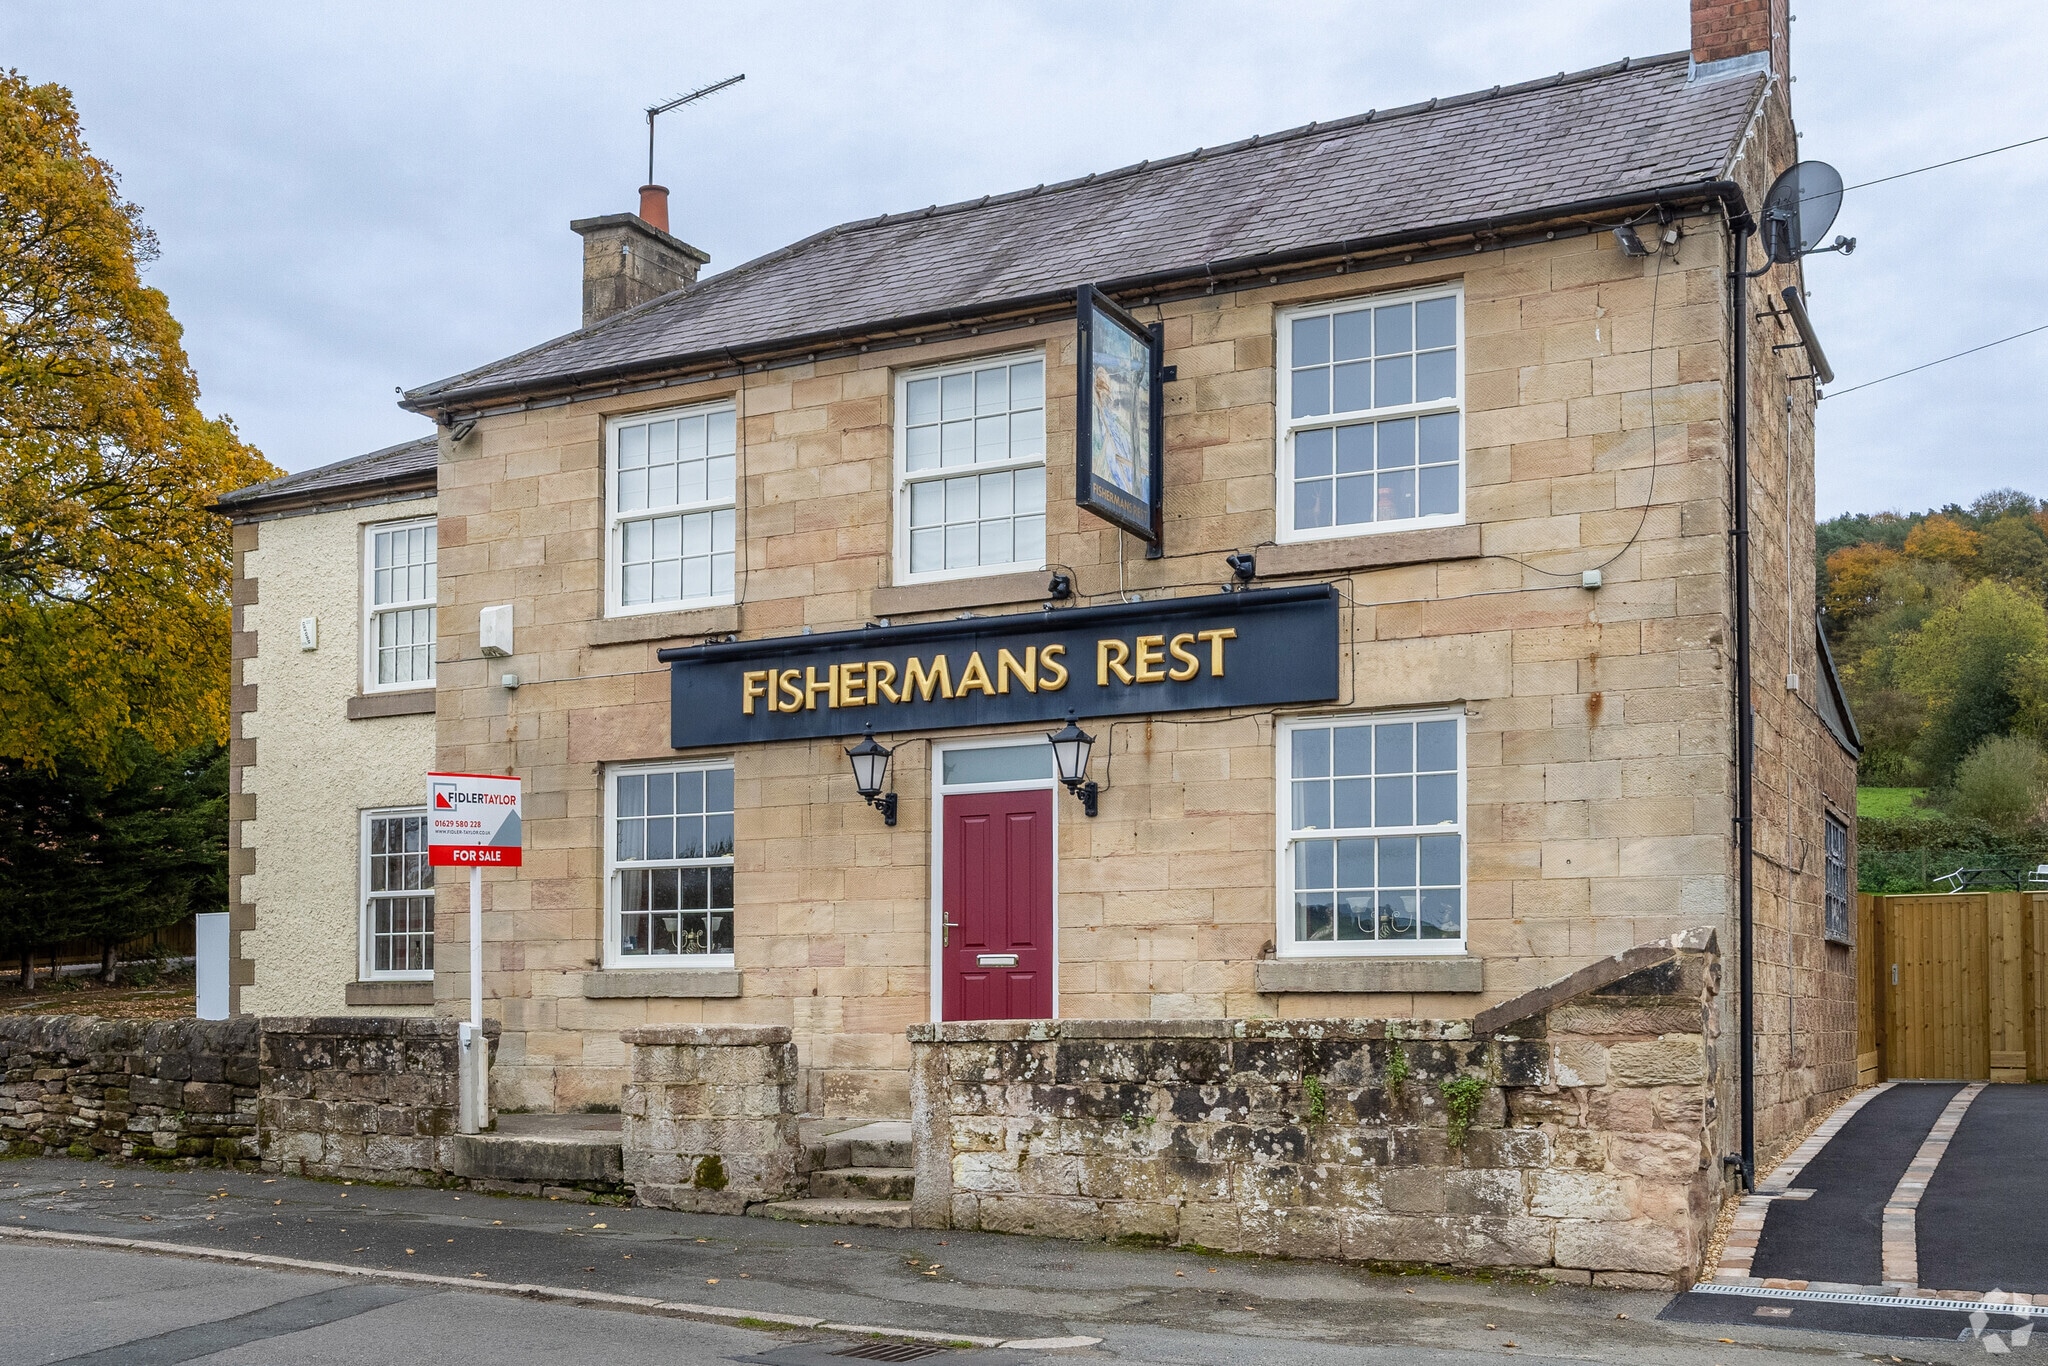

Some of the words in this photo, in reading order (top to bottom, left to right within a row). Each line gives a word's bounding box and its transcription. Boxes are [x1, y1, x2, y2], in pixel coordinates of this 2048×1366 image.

[1092, 482, 1132, 513] FISHERMANS
[742, 643, 1070, 715] FISHERMANS
[1097, 627, 1238, 687] REST
[434, 820, 454, 828] 01629
[455, 820, 469, 828] 580
[469, 820, 482, 828] 228
[453, 850, 476, 861] FOR
[478, 850, 501, 862] SALE
